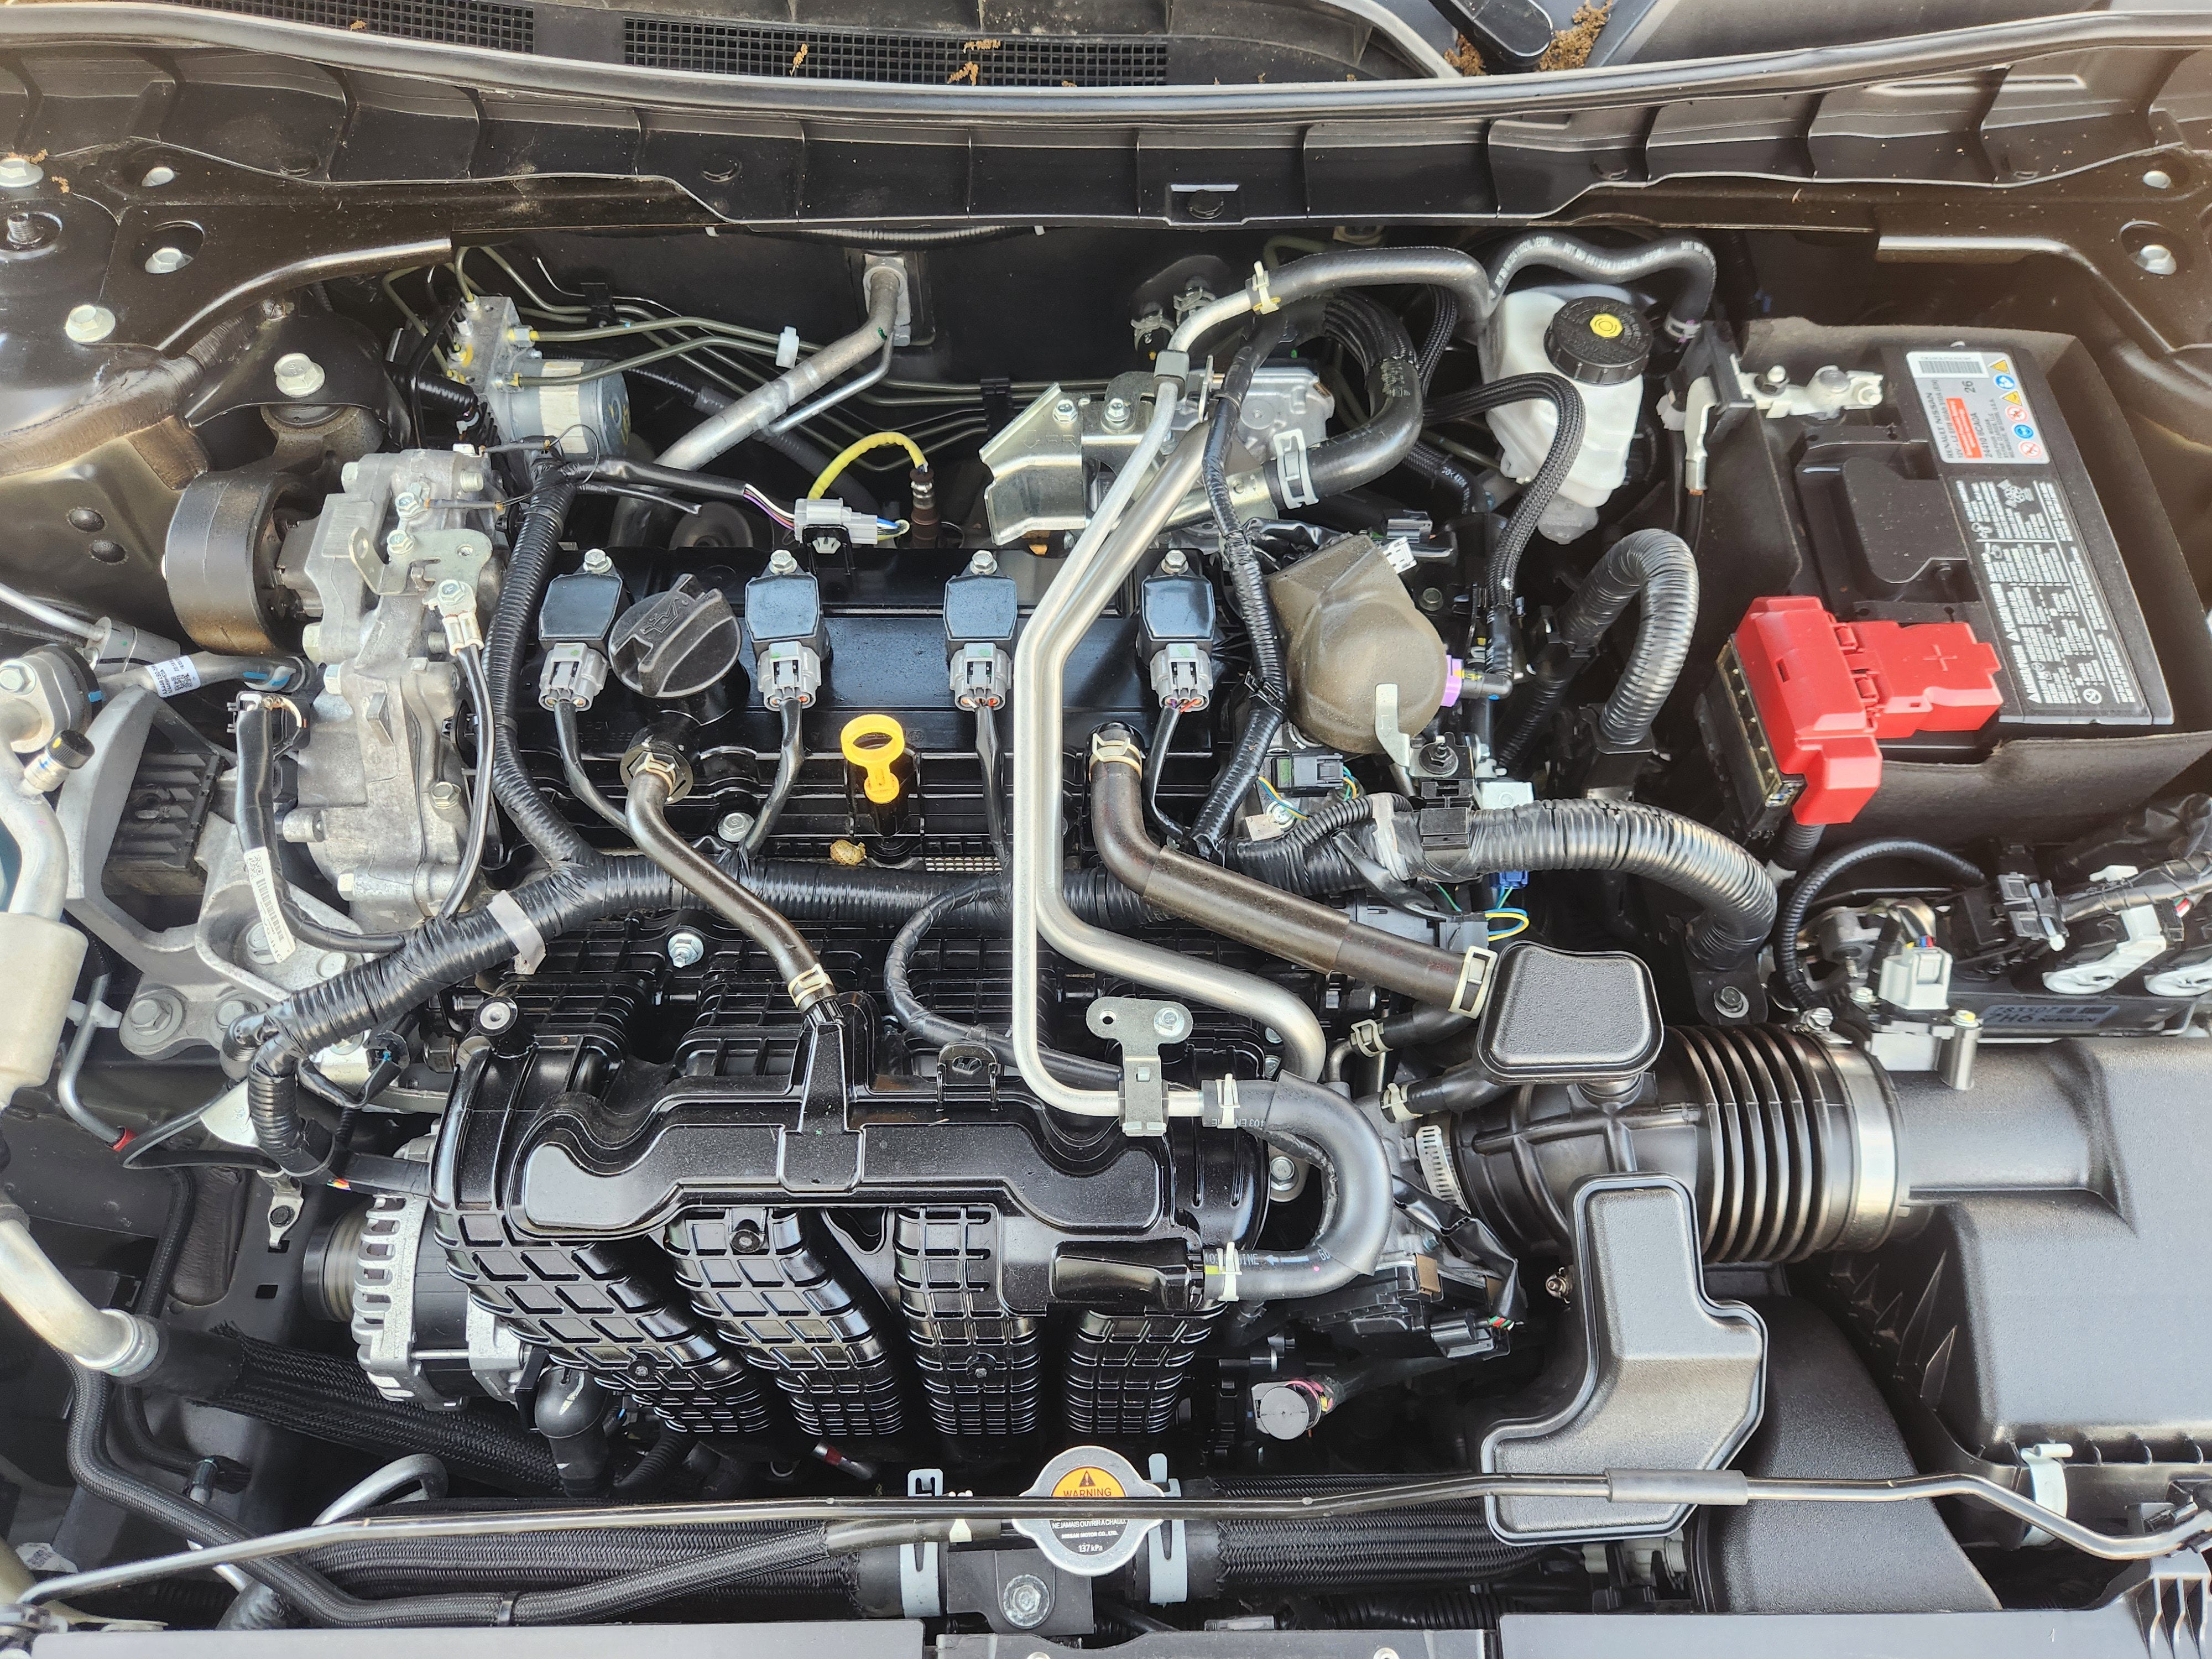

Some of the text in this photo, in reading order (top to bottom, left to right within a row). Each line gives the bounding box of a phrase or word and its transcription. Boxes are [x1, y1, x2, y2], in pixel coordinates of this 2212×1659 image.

[1961, 380, 1976, 393] 26
[1925, 393, 1954, 457] RENAULT NISSAN
[1063, 1488, 1112, 1496] WARNING
[1078, 1543, 1103, 1553] 137 kPa
